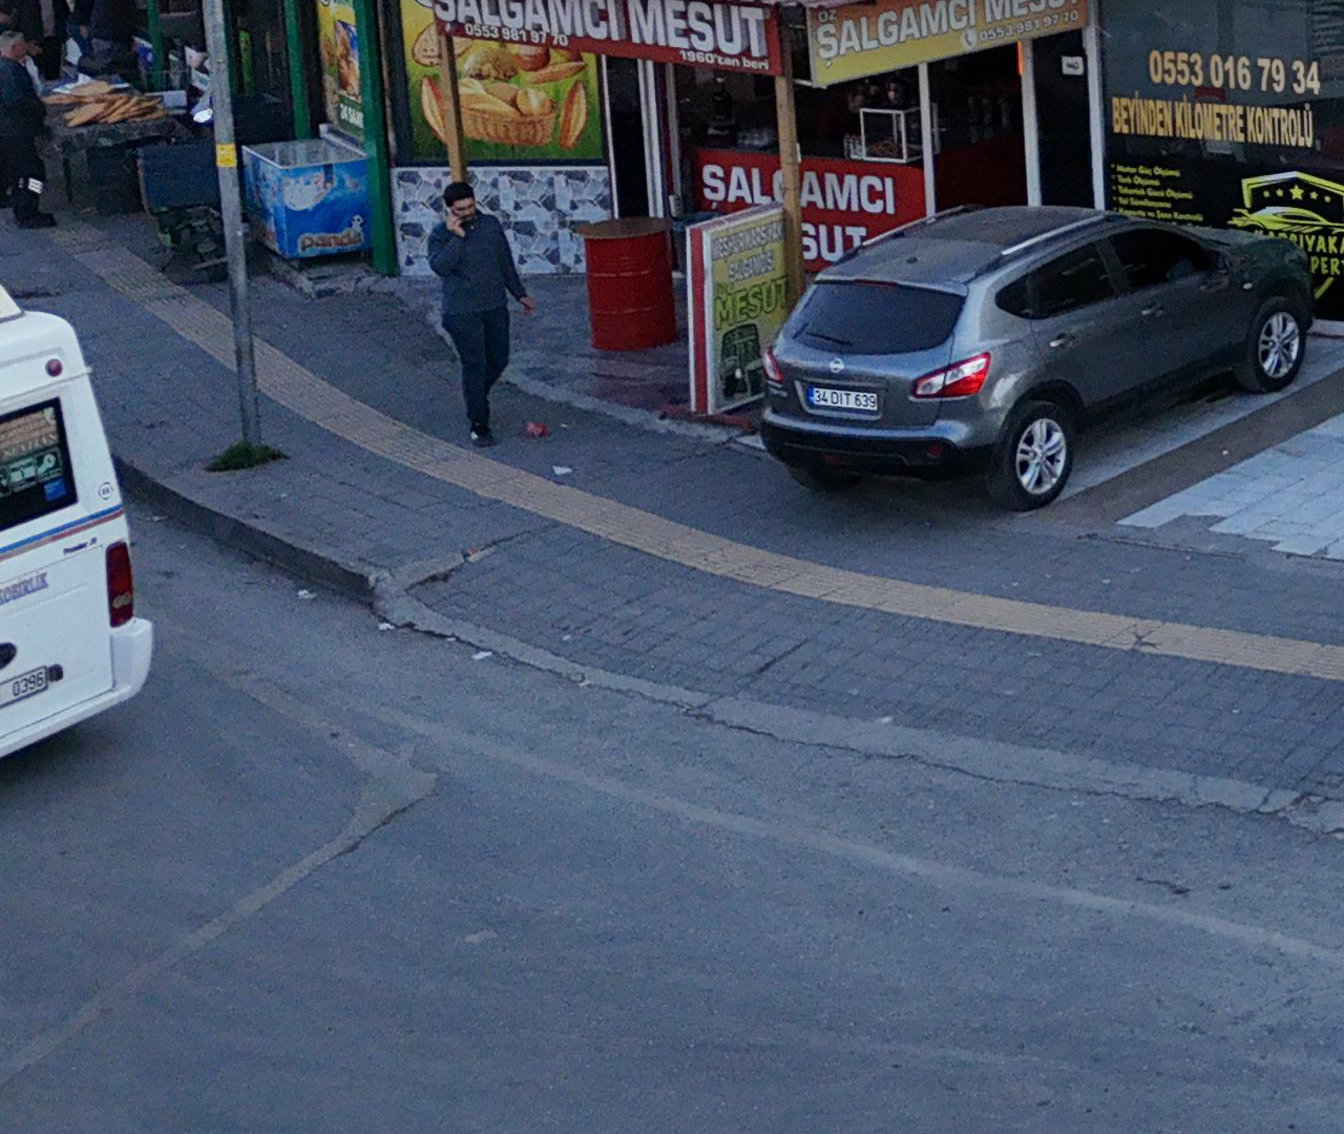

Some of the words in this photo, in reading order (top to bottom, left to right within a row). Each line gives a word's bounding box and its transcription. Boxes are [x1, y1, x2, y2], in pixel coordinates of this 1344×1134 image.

[464, 23, 500, 41] 0553
[501, 27, 528, 42] 981
[530, 30, 547, 44] 97
[550, 33, 569, 47] 70
[979, 24, 1013, 43] 0553
[1015, 18, 1041, 35] 981
[1043, 14, 1060, 29] 97
[1062, 10, 1079, 24] 70
[743, 57, 770, 71] beri
[1150, 49, 1203, 86] 0553
[1209, 54, 1251, 90] 016
[1257, 57, 1286, 93] 79
[1292, 60, 1321, 95] 34
[1111, 90, 1173, 137] BEYİNDEN
[1175, 94, 1245, 143] KİLOMETRE
[1246, 102, 1313, 148] KONTROLÜ
[800, 222, 868, 262] SUT
[714, 274, 789, 330] MESUT
[813, 389, 829, 403] 34
[831, 390, 850, 405] DIT
[853, 392, 876, 408] 639
[12, 672, 45, 697] 0396
